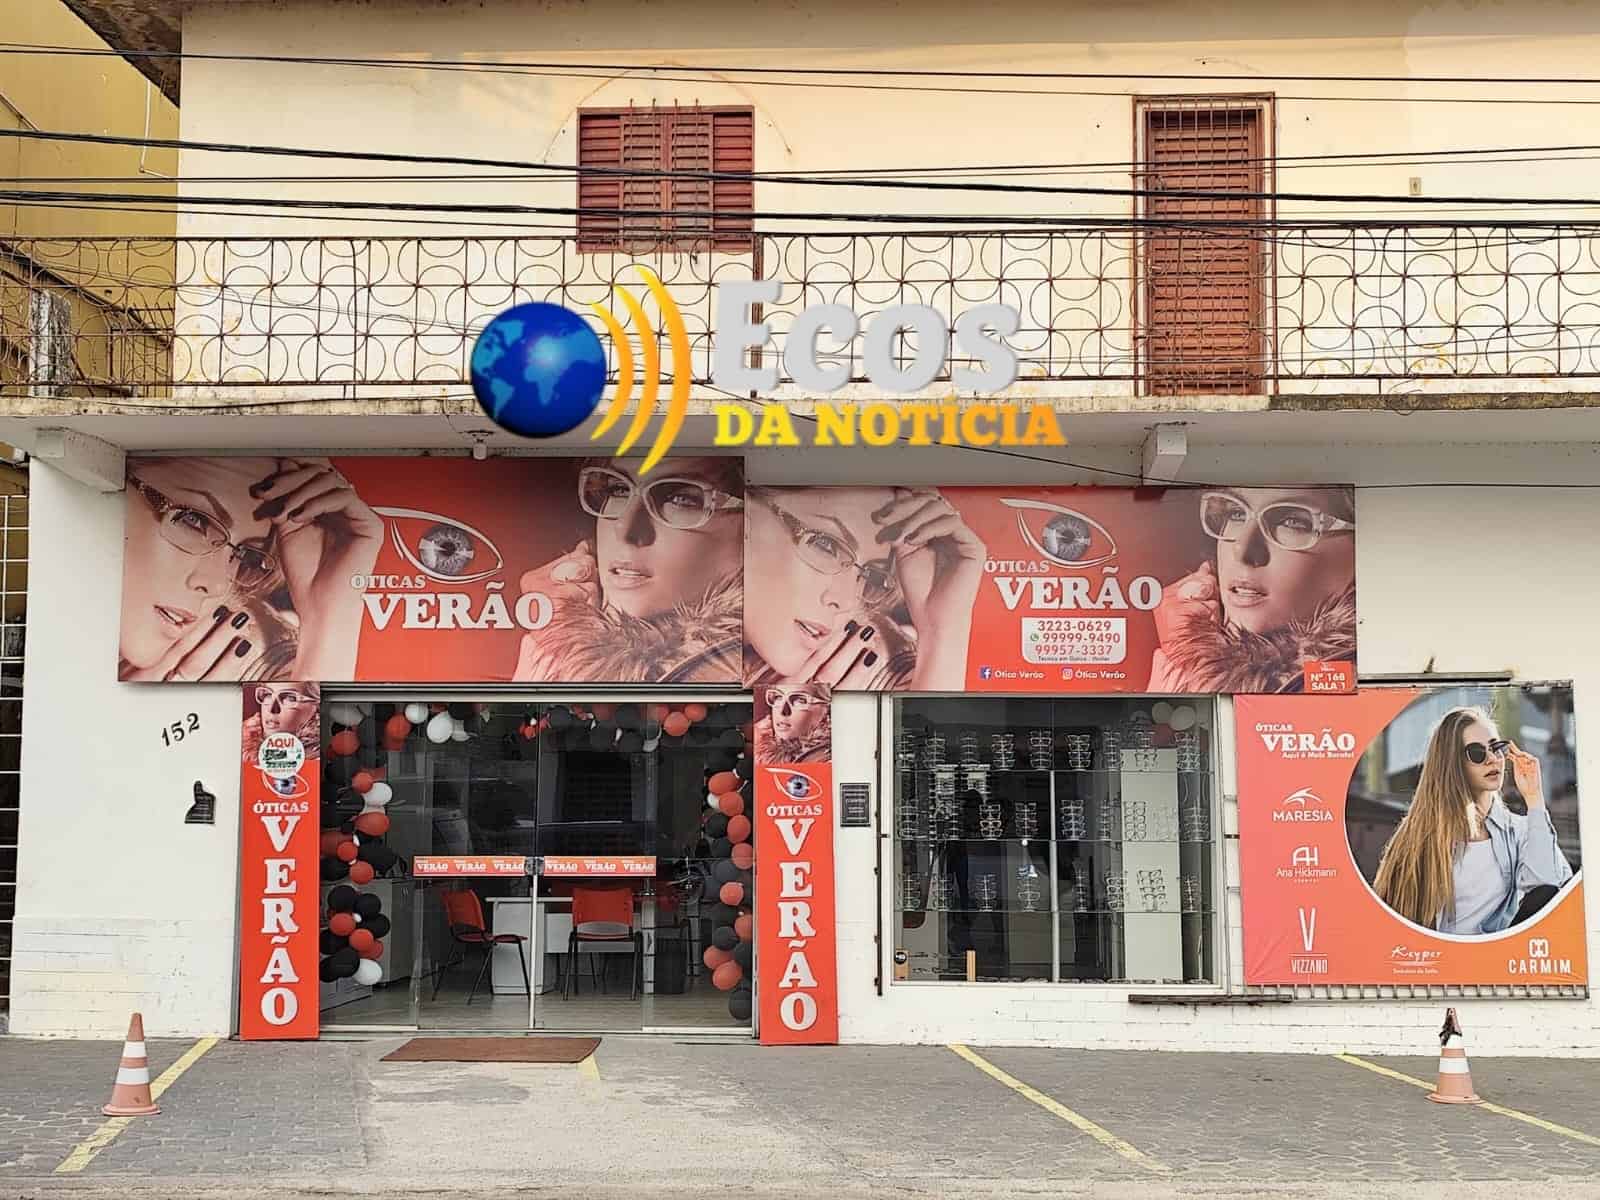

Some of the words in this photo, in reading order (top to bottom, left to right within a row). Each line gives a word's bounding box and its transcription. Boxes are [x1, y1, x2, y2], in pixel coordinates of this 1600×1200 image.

[984, 557, 1050, 574] ÓTICAS
[350, 571, 427, 589] ÓTICAS
[994, 567, 1163, 611] VERÃO
[362, 581, 553, 631] VERÃO
[1037, 620, 1112, 632] 3223-0629
[1042, 632, 1121, 644] 99999-9490
[1035, 644, 1113, 656] 99957-3337
[1312, 682, 1337, 691] SALA
[162, 713, 200, 747] 152
[1255, 723, 1293, 732] ÓTICAS
[267, 738, 294, 748] AQUI
[1261, 728, 1355, 752] VERÃO
[253, 799, 309, 814] ÓTICAS
[766, 802, 822, 817] ÓTICAS
[1273, 810, 1333, 822] MARESIA
[1276, 868, 1293, 877] Ana
[260, 815, 299, 1026] VERÃO
[774, 818, 817, 1031] VERÃO
[1291, 959, 1328, 974] VIZZANO
[1509, 960, 1571, 974] CARMIM
